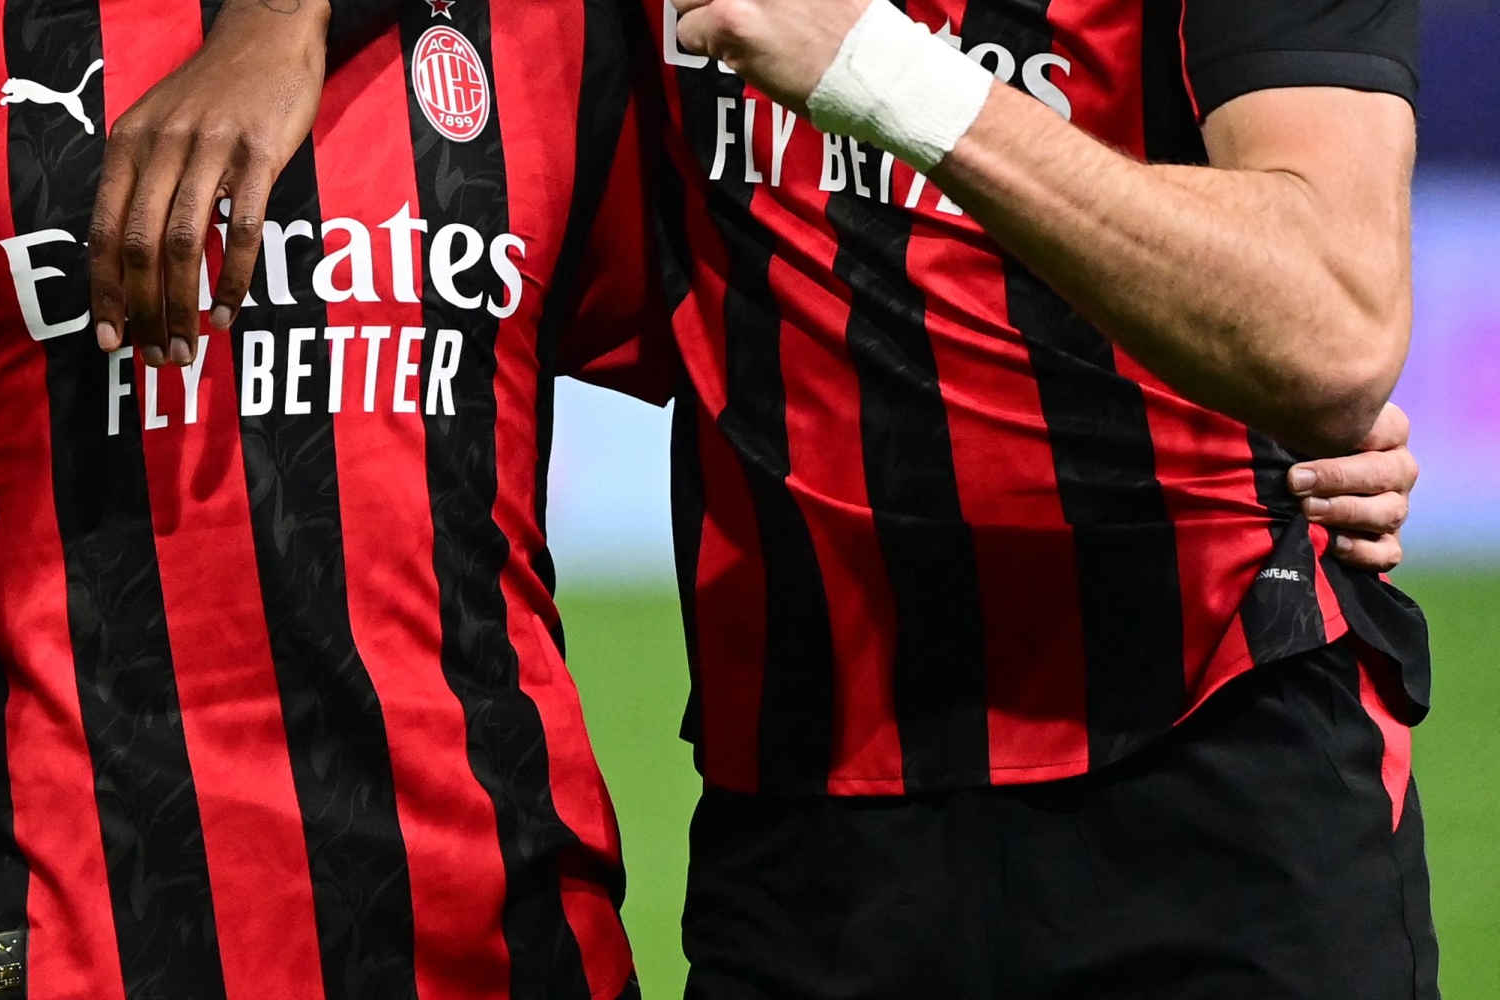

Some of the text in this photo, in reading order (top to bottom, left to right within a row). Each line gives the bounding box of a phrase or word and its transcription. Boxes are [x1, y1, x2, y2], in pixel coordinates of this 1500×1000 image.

[426, 35, 468, 59] ACM
[438, 113, 473, 128] 1899
[708, 96, 797, 188] FLY
[107, 325, 464, 436] FLY BETTER
